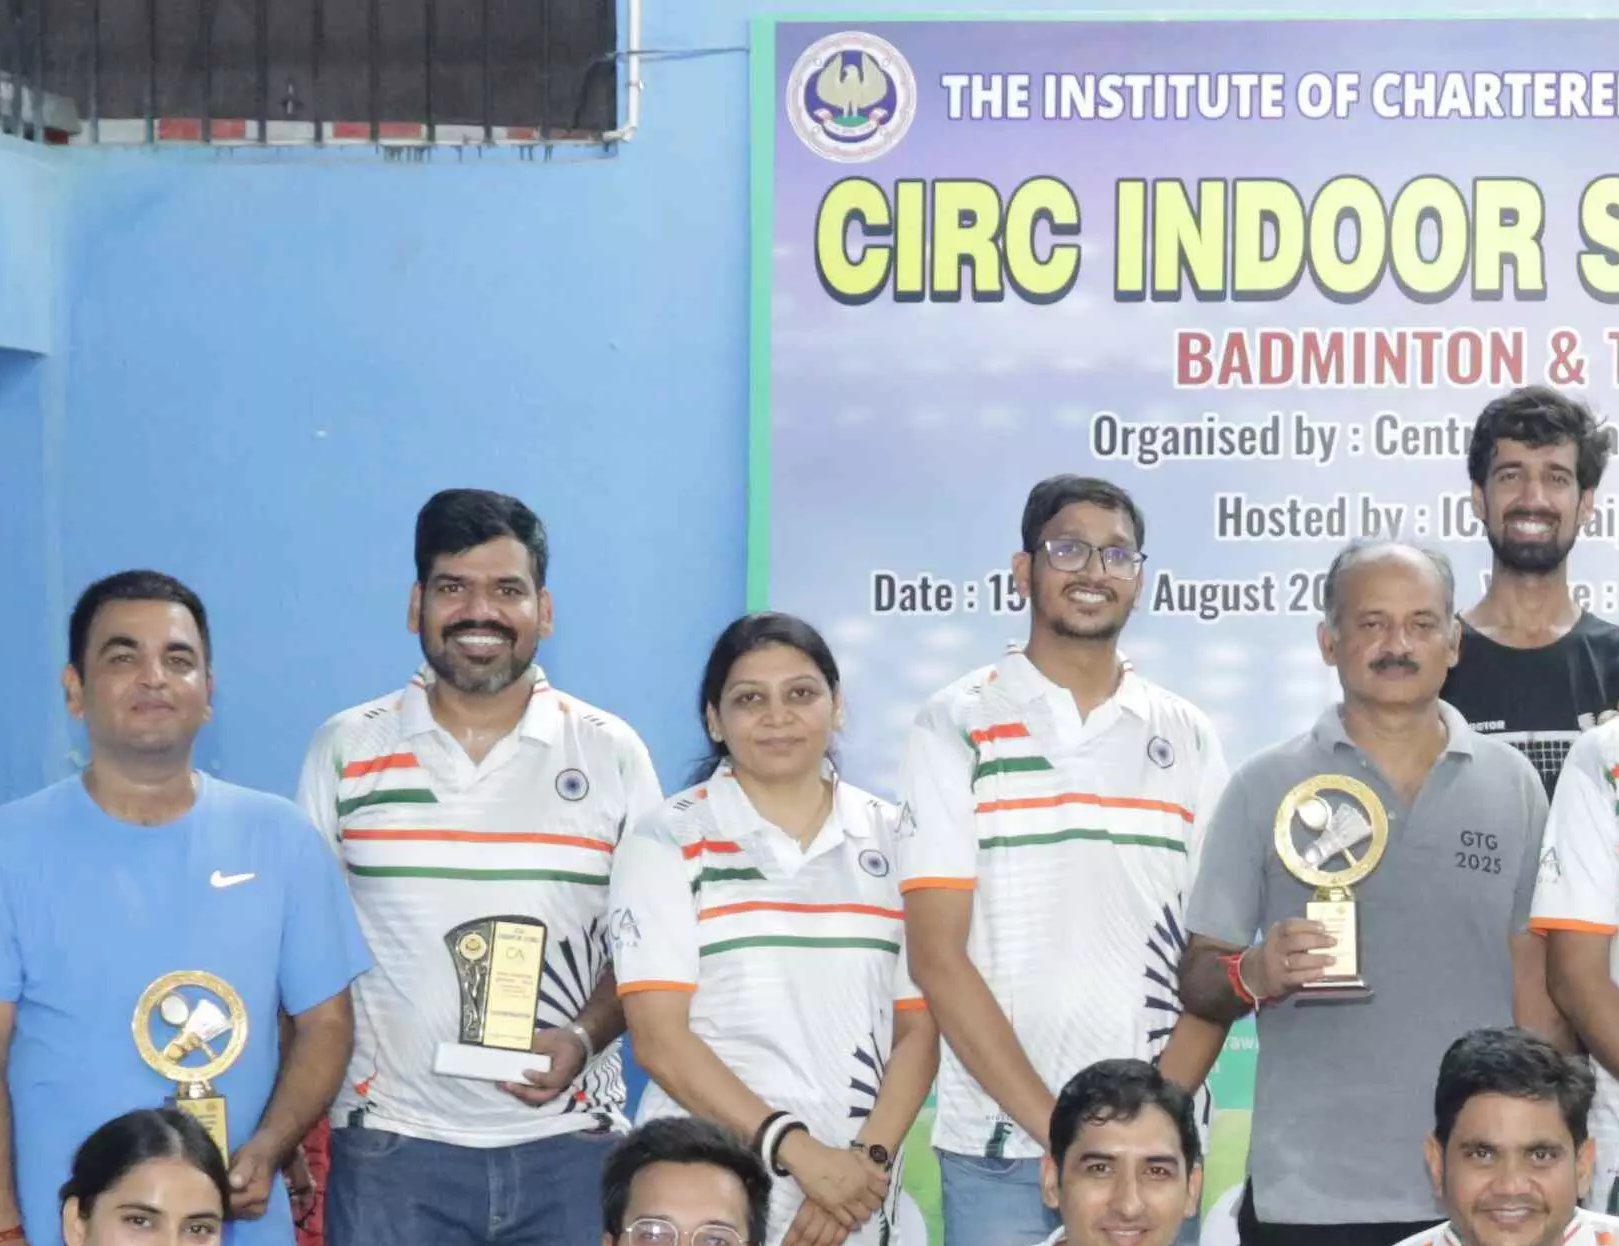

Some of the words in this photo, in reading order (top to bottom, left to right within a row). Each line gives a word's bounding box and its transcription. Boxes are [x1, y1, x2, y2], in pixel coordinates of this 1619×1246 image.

[941, 73, 1030, 120] THE
[1043, 73, 1286, 120] INSTITUTE
[1296, 73, 1358, 120] OF
[816, 175, 1082, 305] CIRC
[1114, 175, 1547, 304] INDOOR
[1179, 330, 1524, 386] BADMINTON
[1548, 331, 1584, 387] &
[1093, 415, 1280, 464] Organised
[1293, 415, 1336, 464] by
[1351, 425, 1360, 455] :
[1375, 414, 1473, 457] Centr
[1218, 496, 1346, 538] Hosted
[1361, 496, 1403, 539] by
[1417, 508, 1426, 534] :
[1441, 497, 1481, 538] IC
[873, 573, 953, 612] Date
[1153, 573, 1275, 620] August
[1288, 573, 1329, 613] 20
[1454, 851, 1502, 875] 2025
[1460, 829, 1498, 851] GTG
